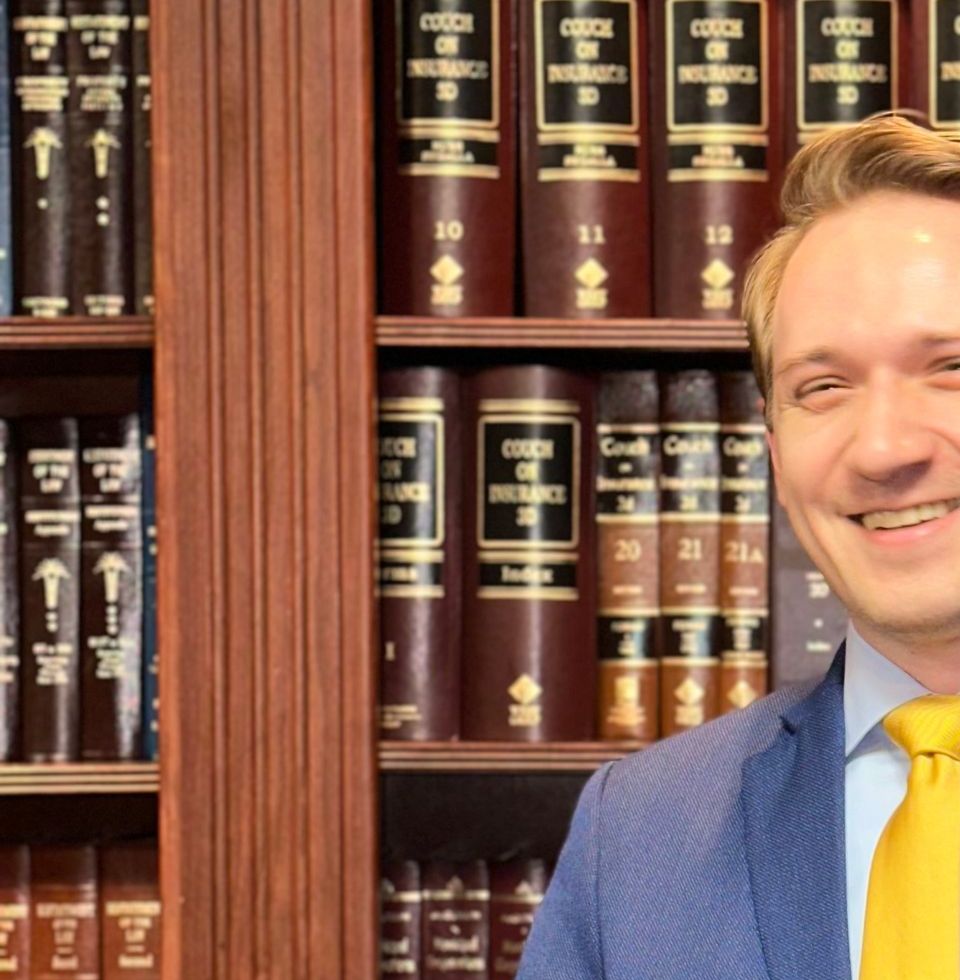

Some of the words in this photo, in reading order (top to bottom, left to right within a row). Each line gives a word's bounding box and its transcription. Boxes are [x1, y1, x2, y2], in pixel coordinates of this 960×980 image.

[420, 13, 473, 33] COUCH
[560, 18, 614, 37] COUCH
[690, 18, 743, 37] COUCH
[821, 18, 874, 36] COUCH
[434, 35, 459, 55] ON
[575, 41, 599, 60] ON
[705, 42, 729, 60] ON
[836, 41, 859, 59] ON
[434, 221, 463, 240] 10
[578, 224, 605, 244] 11
[706, 225, 733, 244] 12
[502, 438, 554, 459] COUCH
[515, 461, 538, 481] ON
[614, 539, 641, 562] 20
[678, 538, 701, 560] 21
